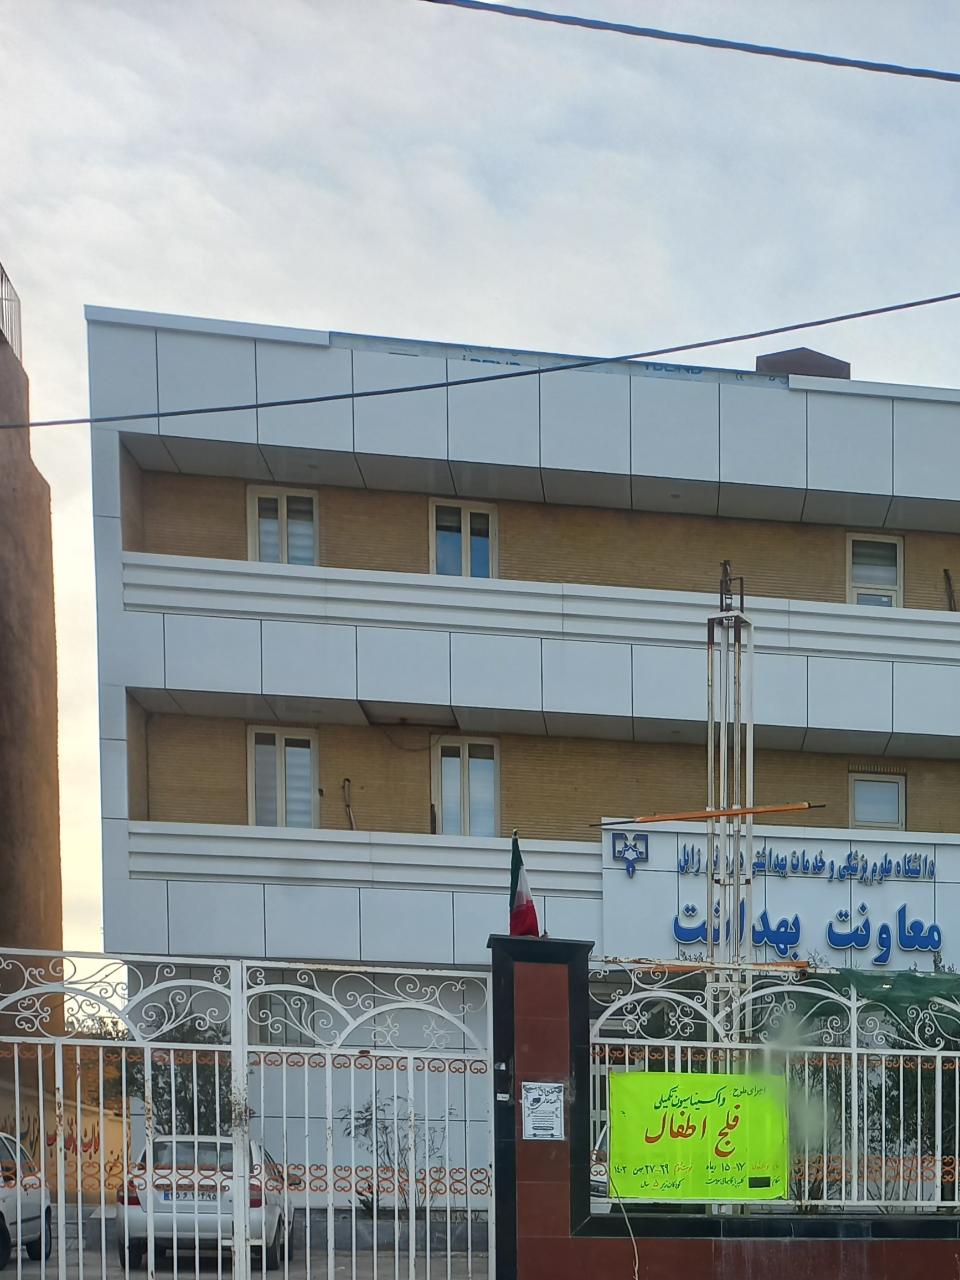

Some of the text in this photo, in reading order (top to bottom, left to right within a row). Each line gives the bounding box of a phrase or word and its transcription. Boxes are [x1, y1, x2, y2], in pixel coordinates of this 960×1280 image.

[679, 842, 701, 875] زابل
[752, 846, 788, 878] بهداشتی
[791, 848, 826, 874] خدمات
[827, 860, 835, 882] و
[837, 849, 868, 886] پزشکی
[870, 852, 893, 884] علوم
[894, 852, 936, 879] دانشگاه
[672, 897, 943, 965] معاونت بهداشت
[653, 1084, 727, 1110] واکسیناسیون تکمیلی
[644, 1104, 741, 1157] فلج اطفال
